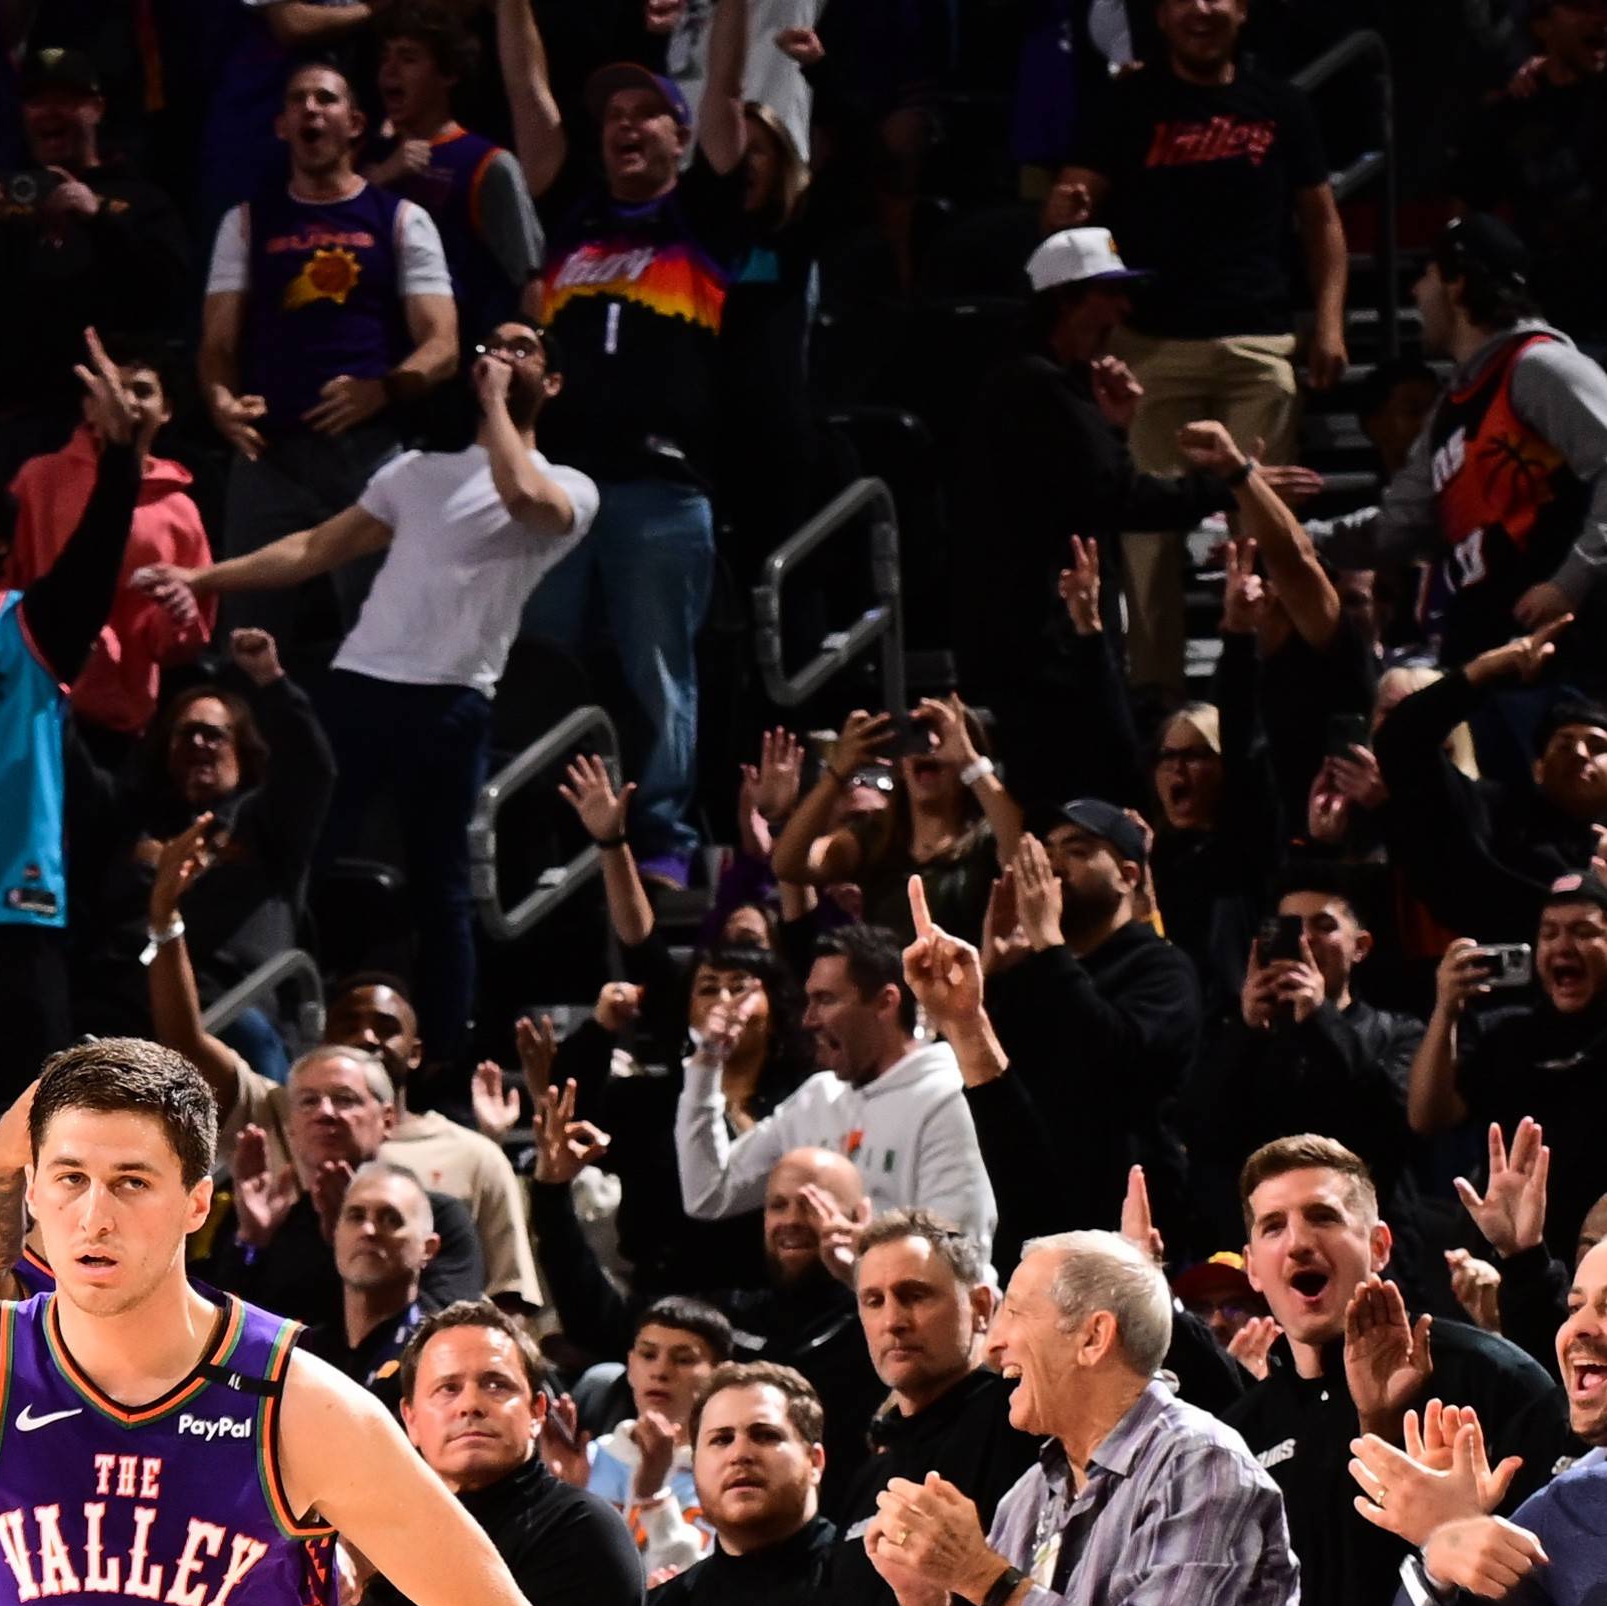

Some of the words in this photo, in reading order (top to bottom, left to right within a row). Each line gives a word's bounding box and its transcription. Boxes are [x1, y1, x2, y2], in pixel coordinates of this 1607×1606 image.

[604, 301, 622, 356] 1
[226, 1371, 242, 1391] AL
[178, 1413, 252, 1442] PayPal
[94, 1453, 162, 1500] THE
